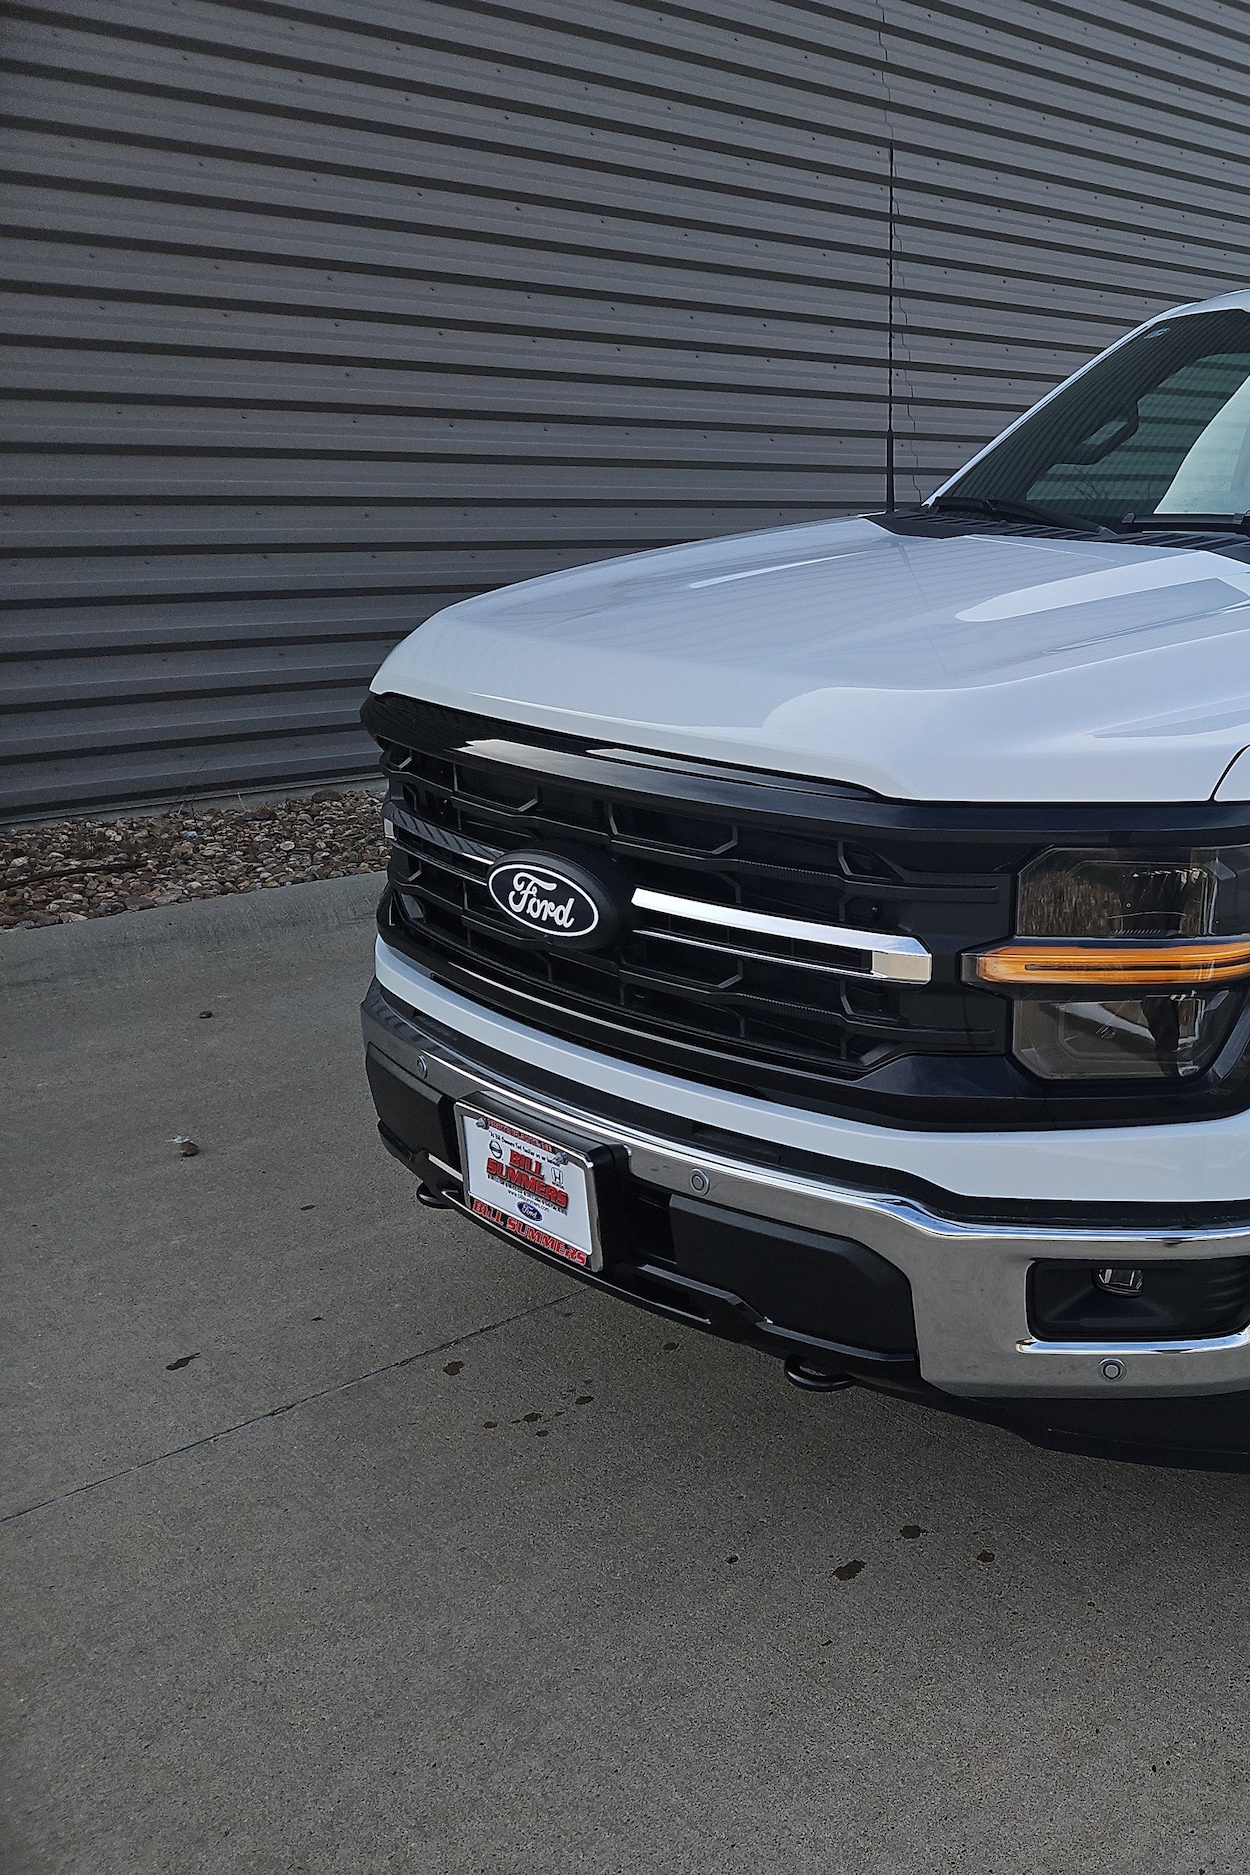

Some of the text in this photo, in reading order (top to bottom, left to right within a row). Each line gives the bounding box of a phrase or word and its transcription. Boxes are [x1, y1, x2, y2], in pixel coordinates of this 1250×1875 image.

[508, 872, 575, 928] Ford
[486, 1157, 569, 1209] SUMMERS
[509, 1149, 545, 1181] BILL
[473, 1199, 587, 1266] BILL SUMMERS
